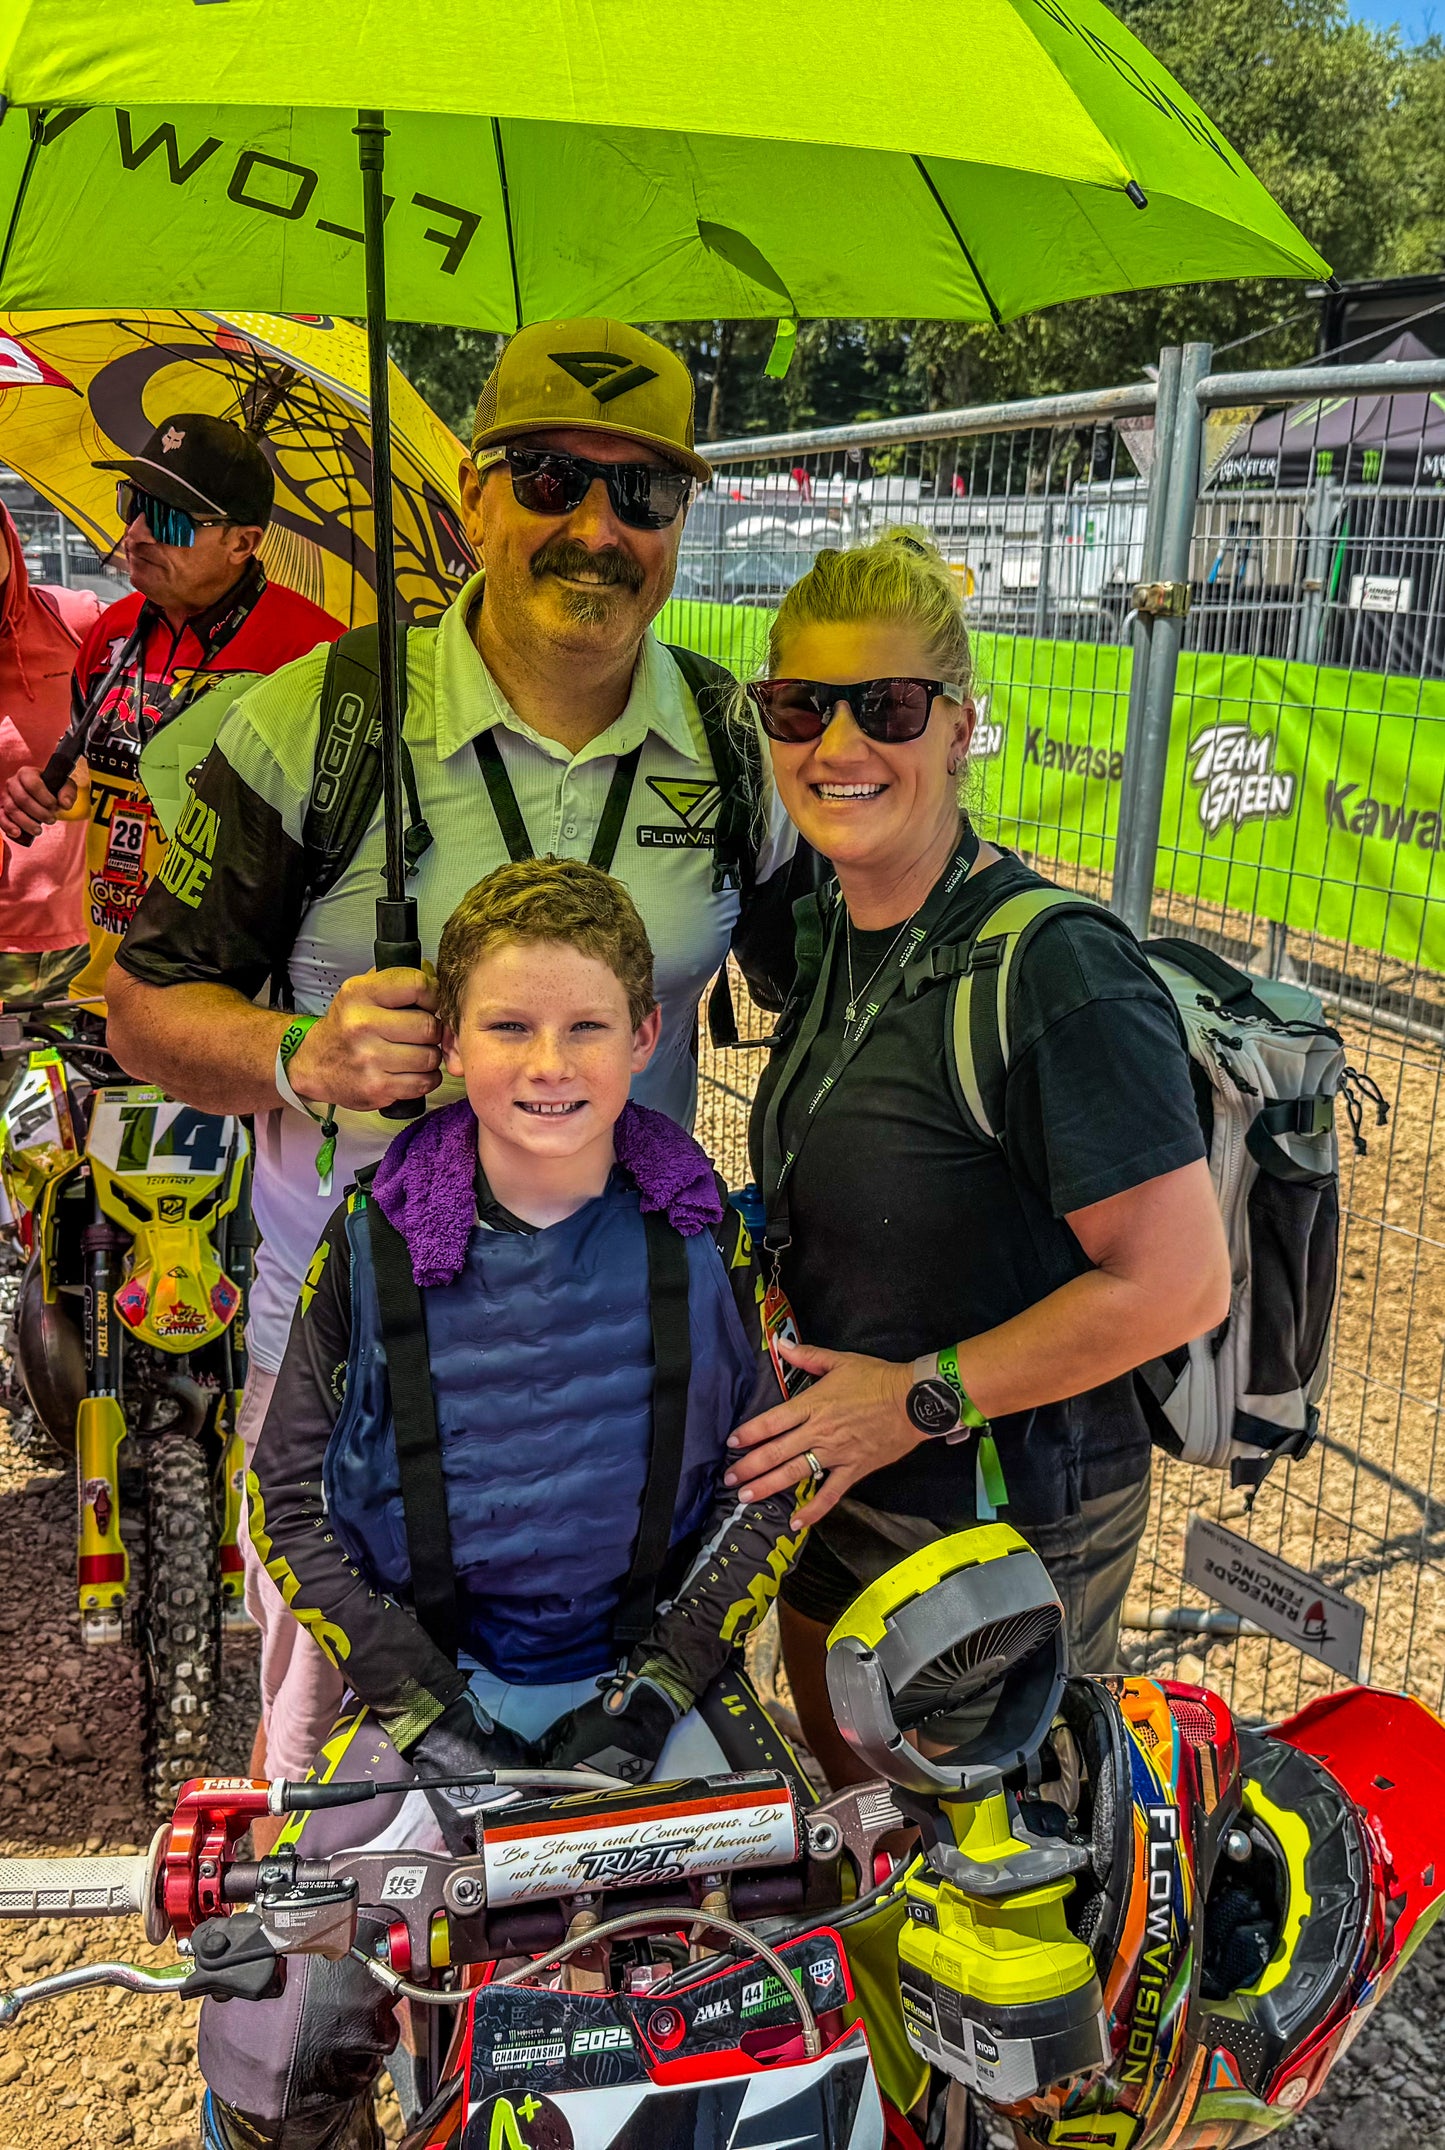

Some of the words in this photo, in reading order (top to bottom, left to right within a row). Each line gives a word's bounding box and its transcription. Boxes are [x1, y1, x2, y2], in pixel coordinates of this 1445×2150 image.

[313, 692, 364, 812] OGIO
[1190, 725, 1272, 781] TEAM
[1201, 773, 1293, 831] GREEN
[112, 820, 142, 850] 28
[116, 1106, 227, 1171] 14
[157, 1326, 209, 1337] CANADA
[1205, 1558, 1299, 1622] RENEGADE
[1231, 1559, 1304, 1604] FENCING
[202, 1779, 255, 1790] T-REX
[494, 1846, 530, 1867] Be
[534, 1840, 597, 1861] Strong
[602, 1829, 640, 1847] and
[640, 1818, 742, 1843] Courageous.
[749, 1808, 784, 1827] Do
[509, 1863, 540, 1880] not
[540, 1861, 558, 1876] be
[713, 1833, 772, 1849] because
[511, 1883, 531, 1900] of
[732, 1845, 777, 1864] God
[583, 1842, 687, 1880] TRUST
[693, 1999, 734, 2024] AMA
[744, 1985, 762, 2003] 44
[495, 2045, 564, 2063] CHAMPIONSHIP
[573, 2028, 634, 2052] 2025
[975, 2040, 997, 2057] RYOBI
